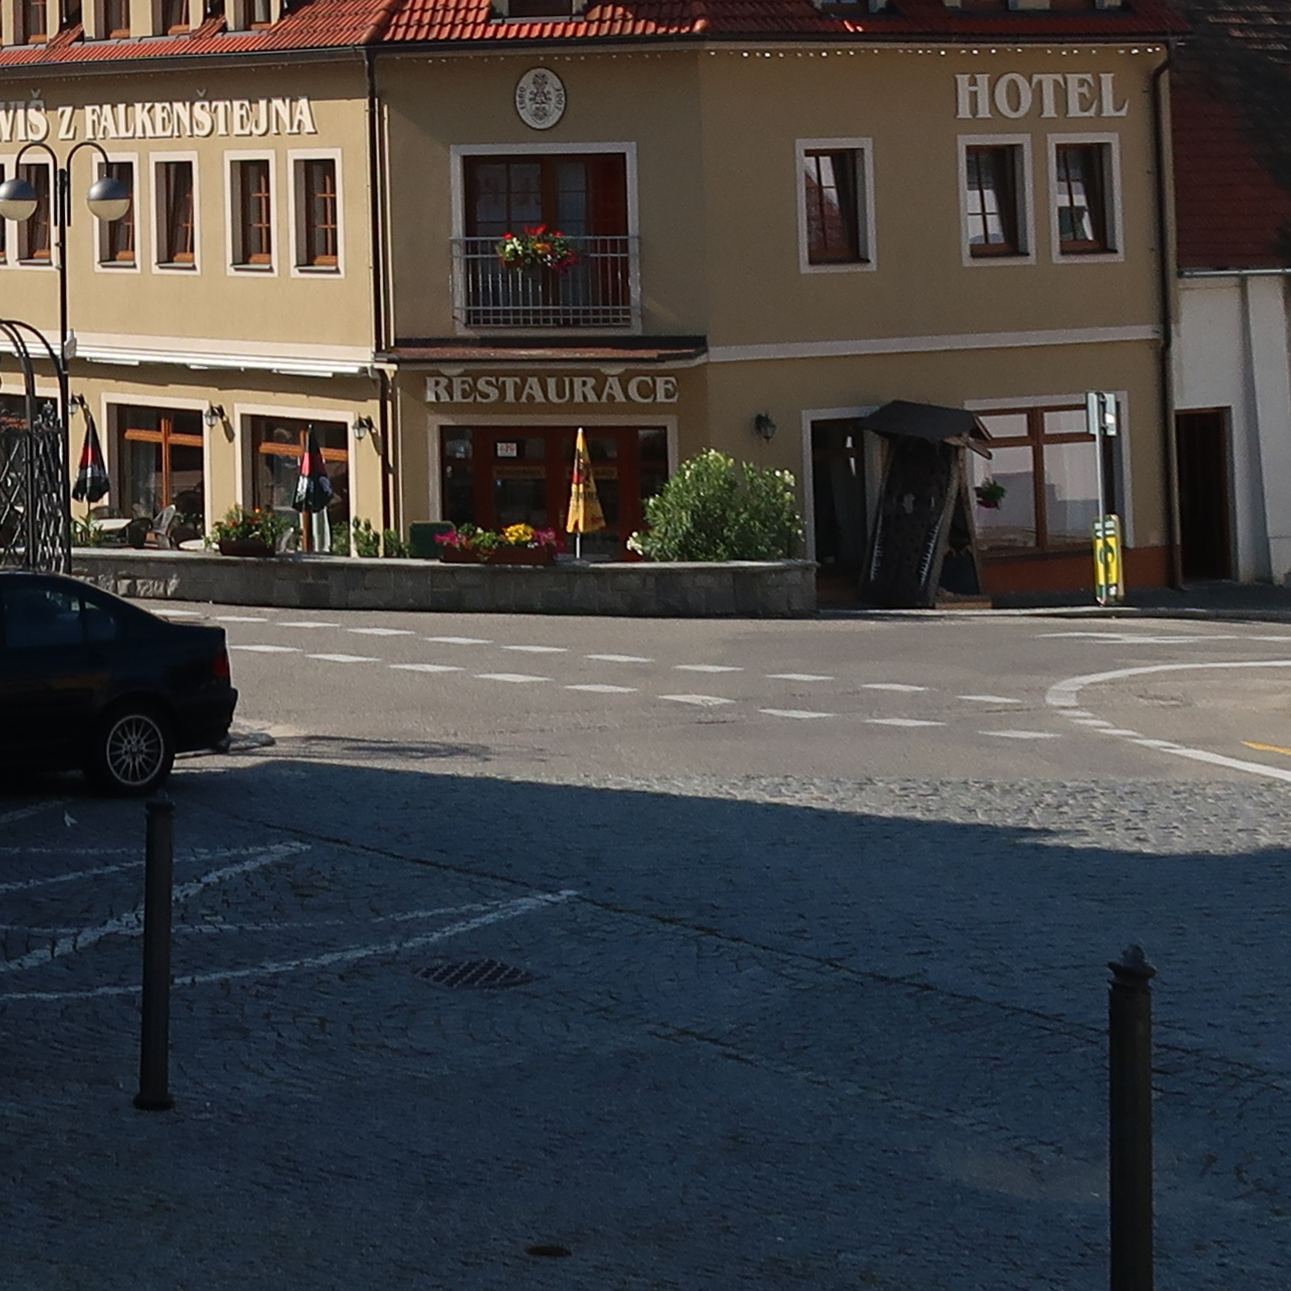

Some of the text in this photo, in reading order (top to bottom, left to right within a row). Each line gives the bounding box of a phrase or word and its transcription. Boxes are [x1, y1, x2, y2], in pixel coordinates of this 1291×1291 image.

[58, 105, 77, 140] Z
[84, 88, 317, 140] FALKENŠTEJNA
[954, 72, 1129, 119] HOTEL
[425, 376, 679, 404] RESTAURACE
